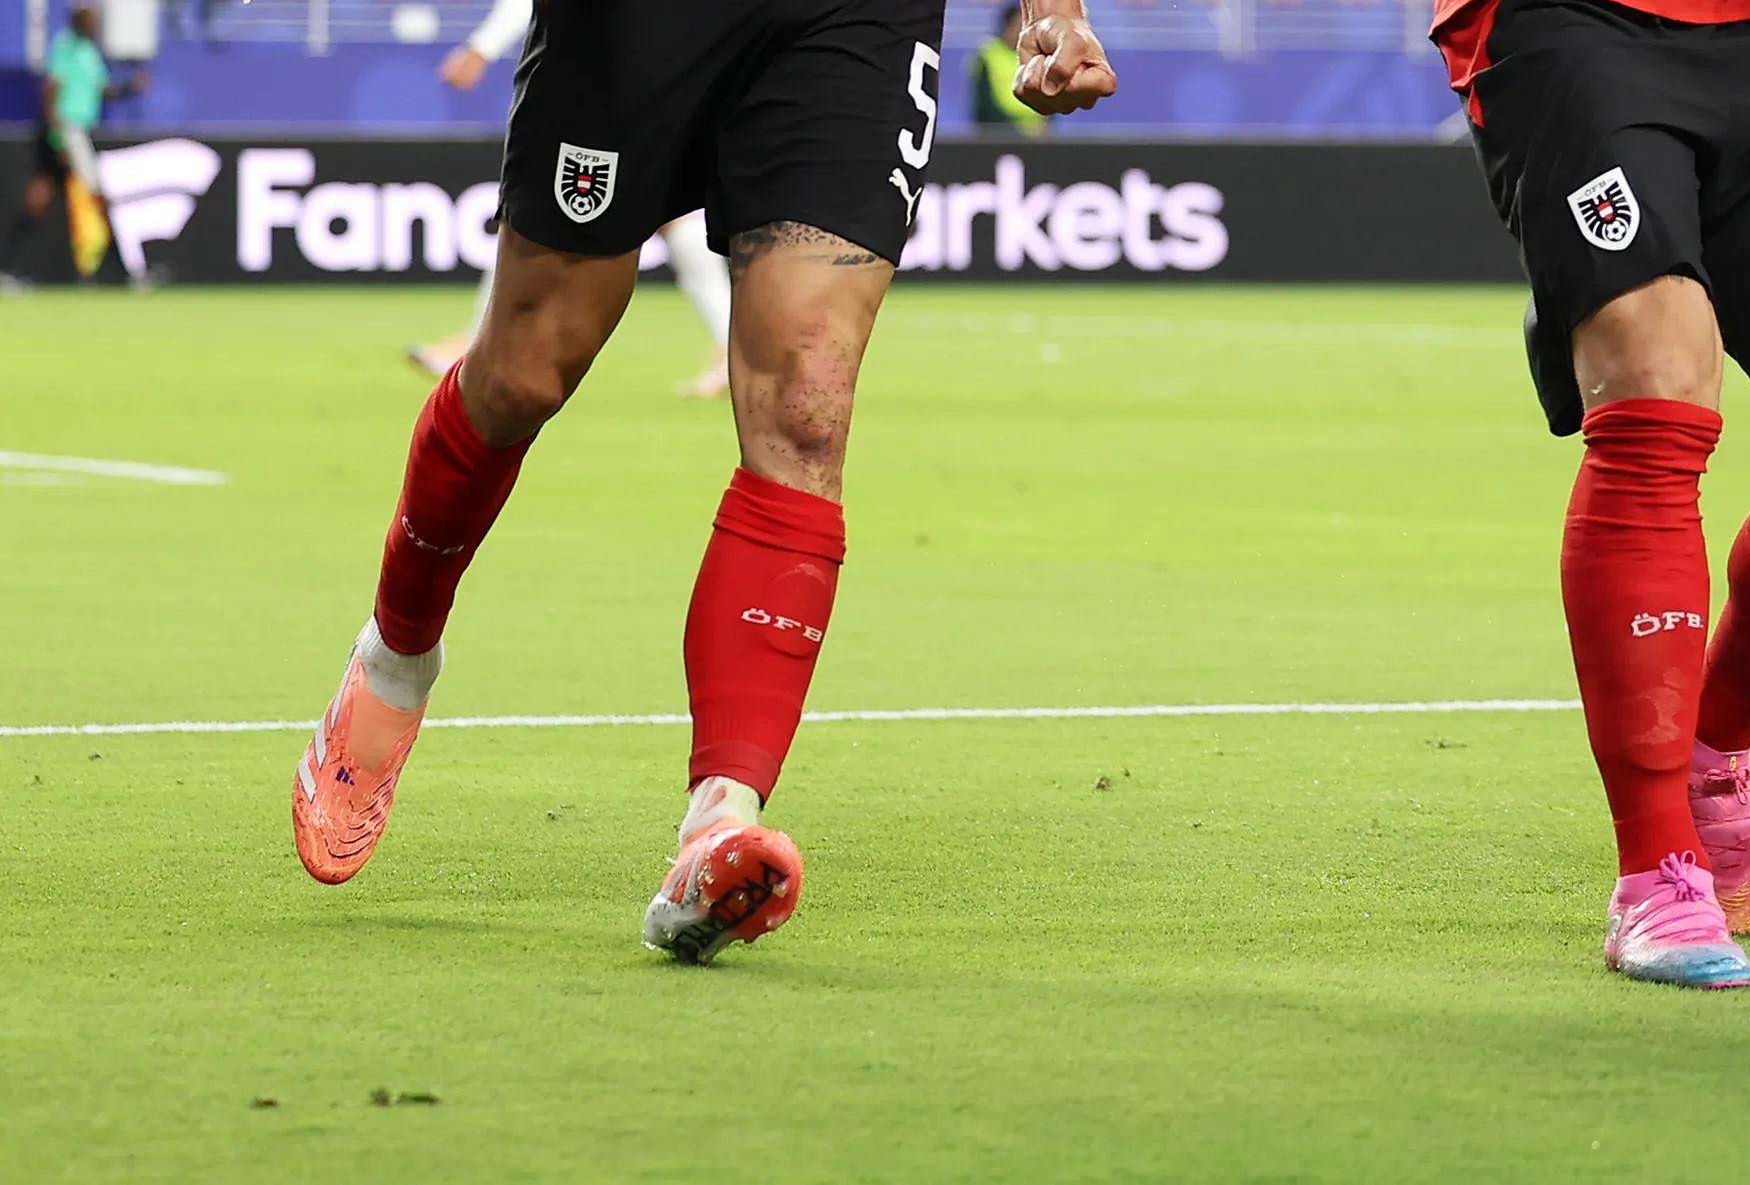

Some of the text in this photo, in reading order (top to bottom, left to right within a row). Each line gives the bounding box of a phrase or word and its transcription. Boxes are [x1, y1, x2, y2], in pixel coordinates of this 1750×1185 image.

[897, 41, 940, 169] 5
[740, 607, 823, 642] ÖFB
[1631, 611, 1704, 637] ÖFB
